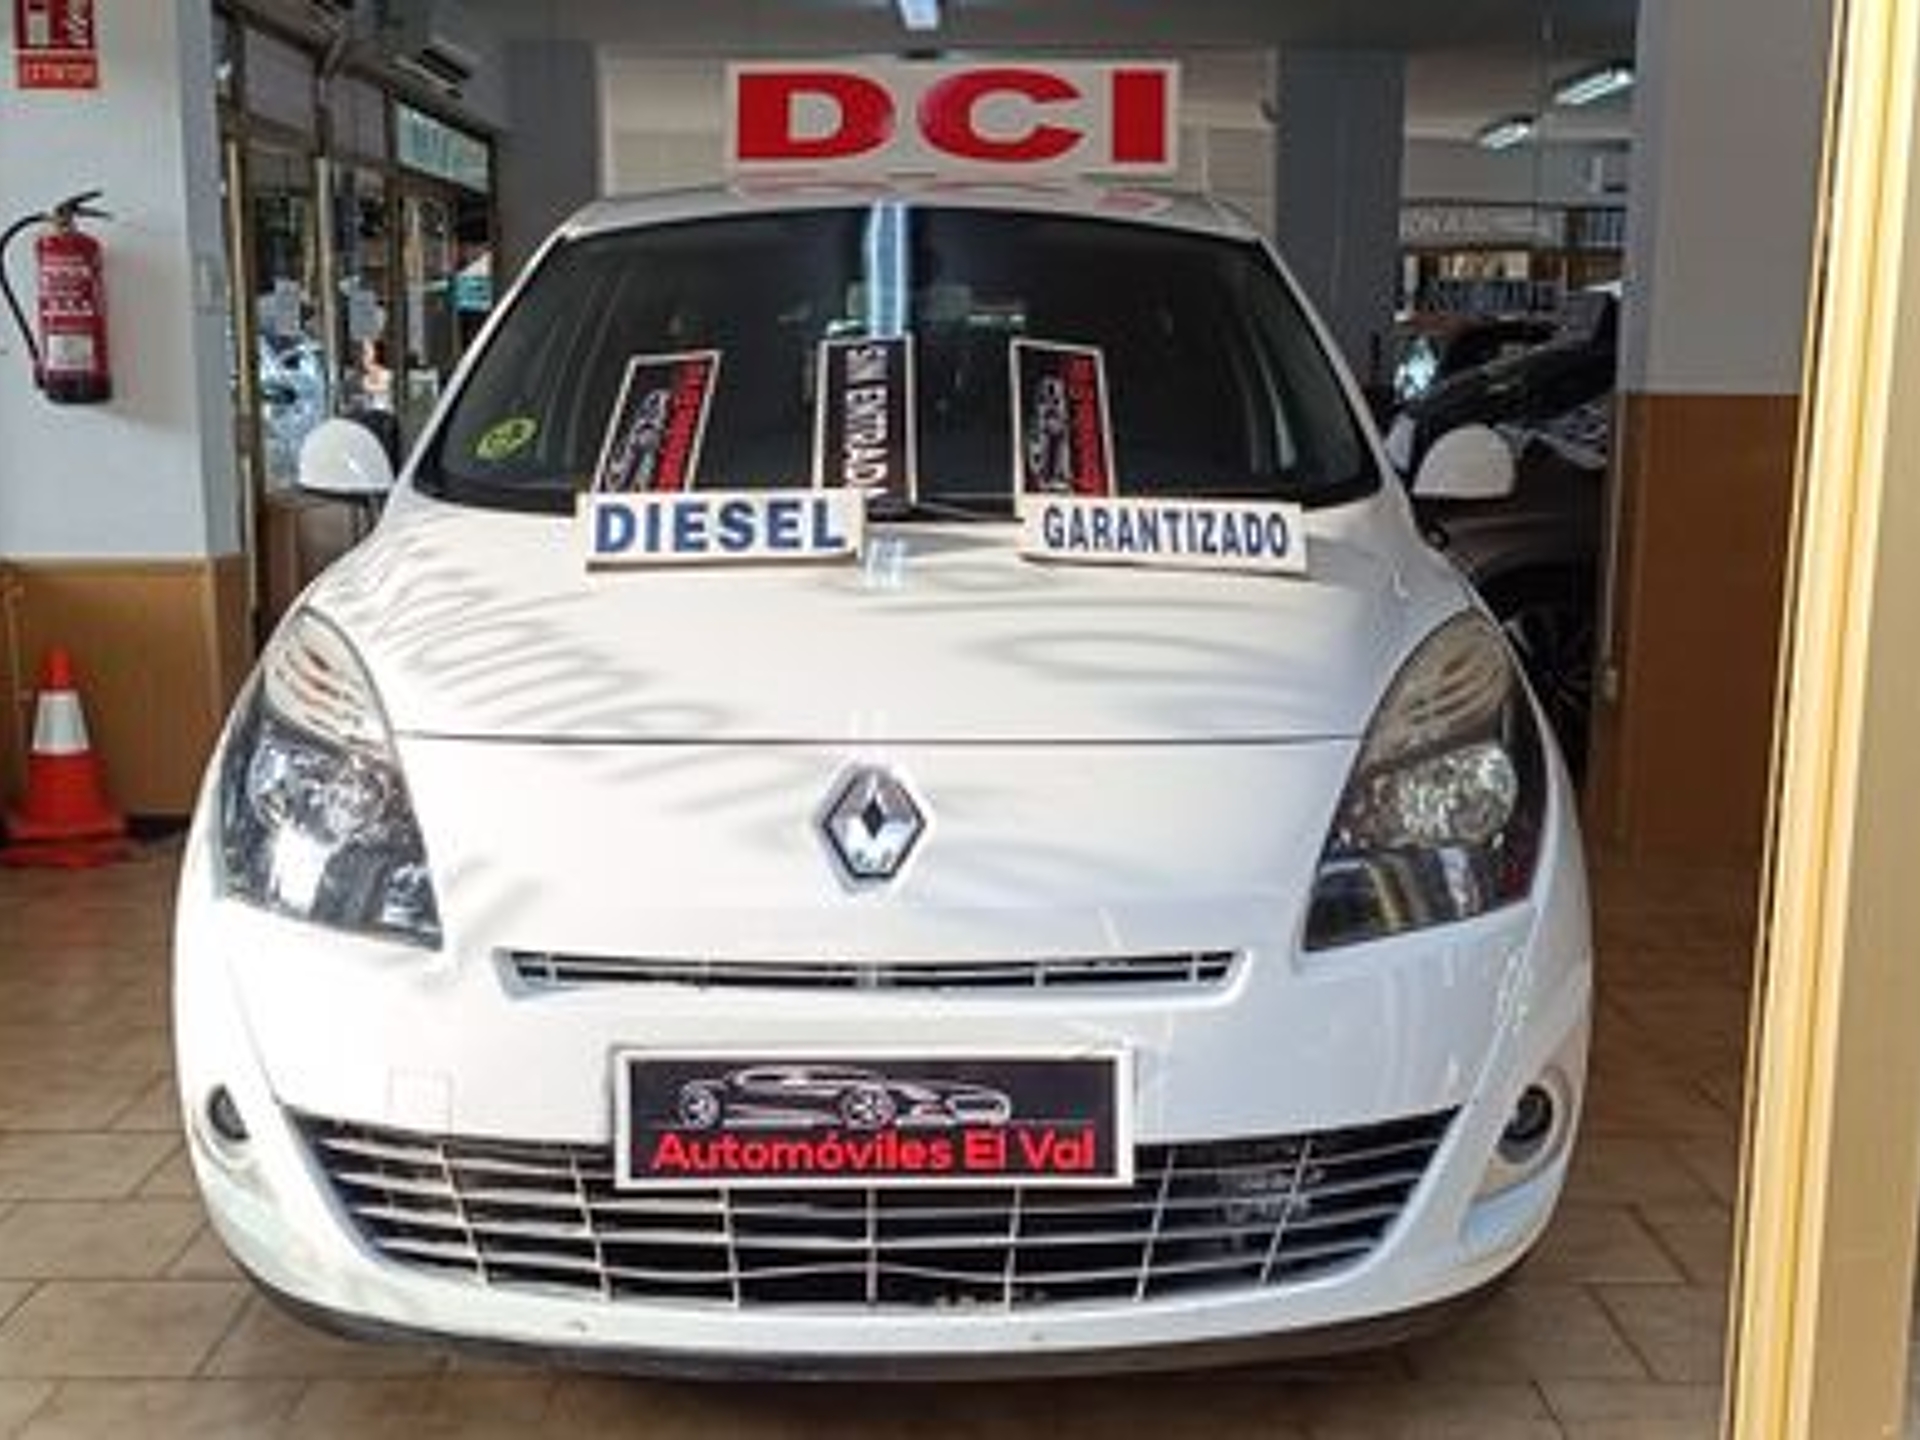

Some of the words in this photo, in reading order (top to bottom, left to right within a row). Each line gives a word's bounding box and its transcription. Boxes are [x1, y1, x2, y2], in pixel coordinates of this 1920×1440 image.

[738, 68, 1168, 163] DCI
[595, 500, 846, 553] DIESEL
[1043, 504, 1289, 558] GARANTIZADO
[653, 1131, 954, 1171] Automóviles
[964, 1129, 1006, 1171] El
[1018, 1128, 1096, 1171] Val
